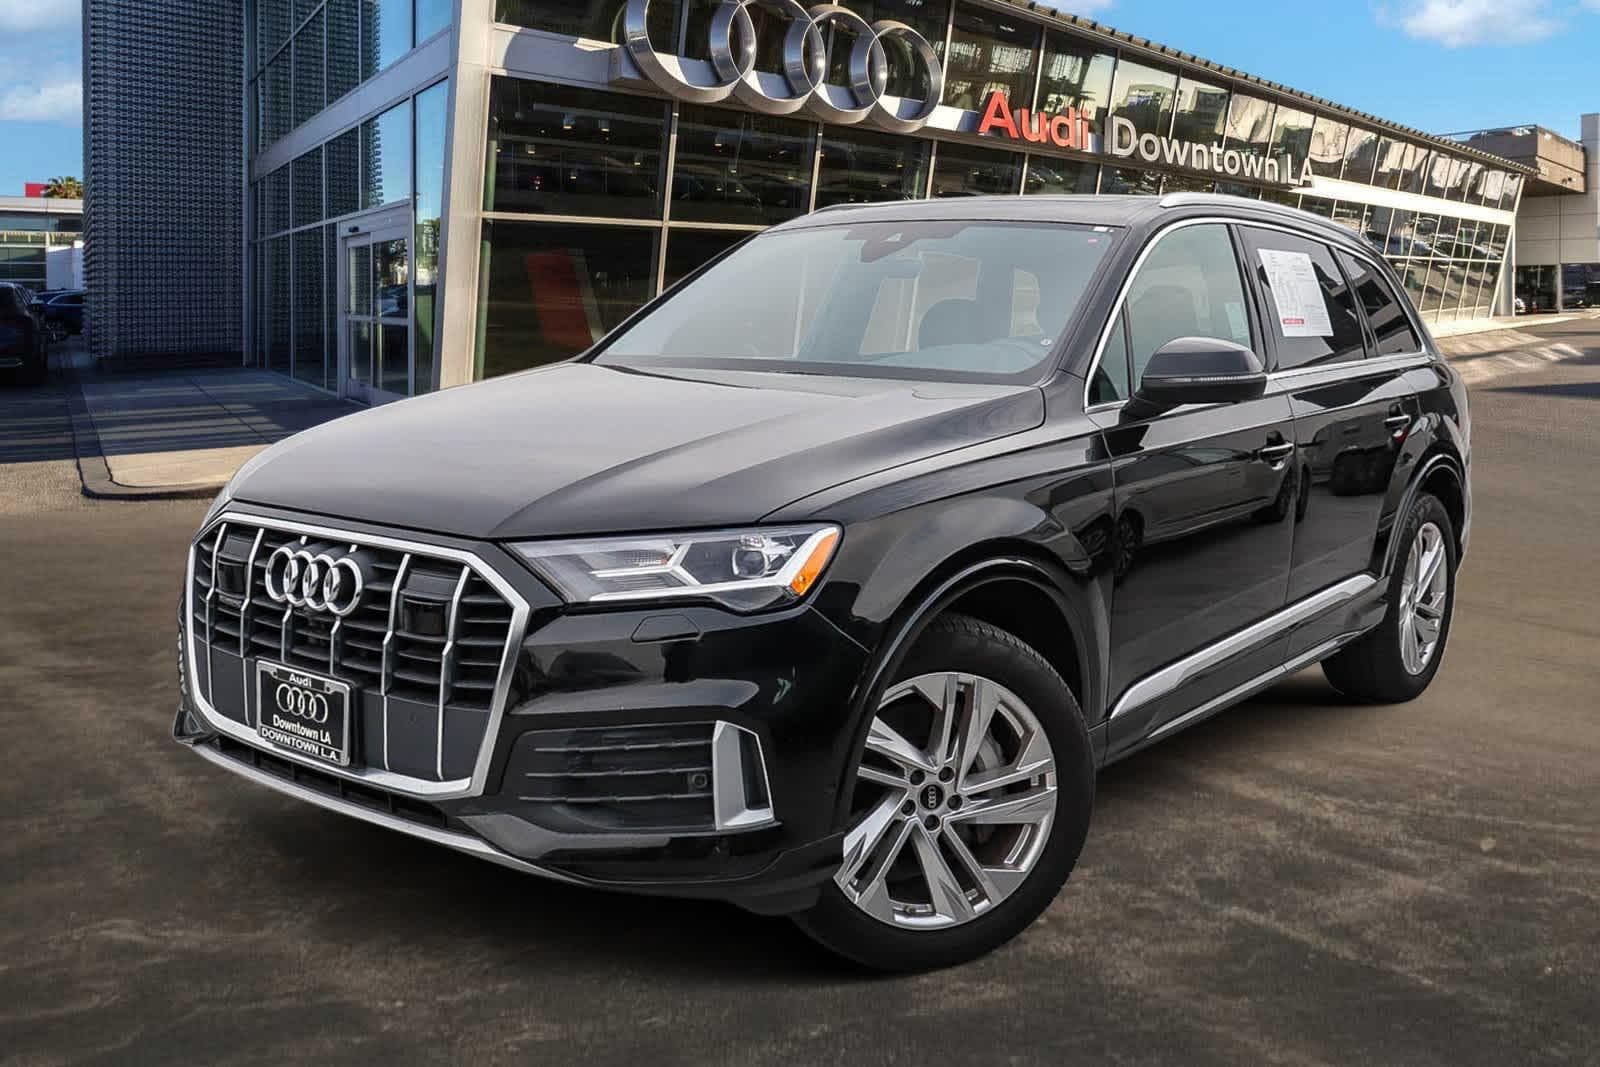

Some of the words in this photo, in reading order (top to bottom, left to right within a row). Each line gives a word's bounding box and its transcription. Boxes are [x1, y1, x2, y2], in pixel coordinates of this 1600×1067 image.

[978, 91, 1090, 150] Audi
[1106, 115, 1279, 183] Downtown
[1287, 154, 1315, 187] LA
[289, 673, 312, 688] Audi
[261, 727, 319, 755] DOWNTOWN
[272, 714, 318, 741] Downtown
[320, 730, 331, 745] LA
